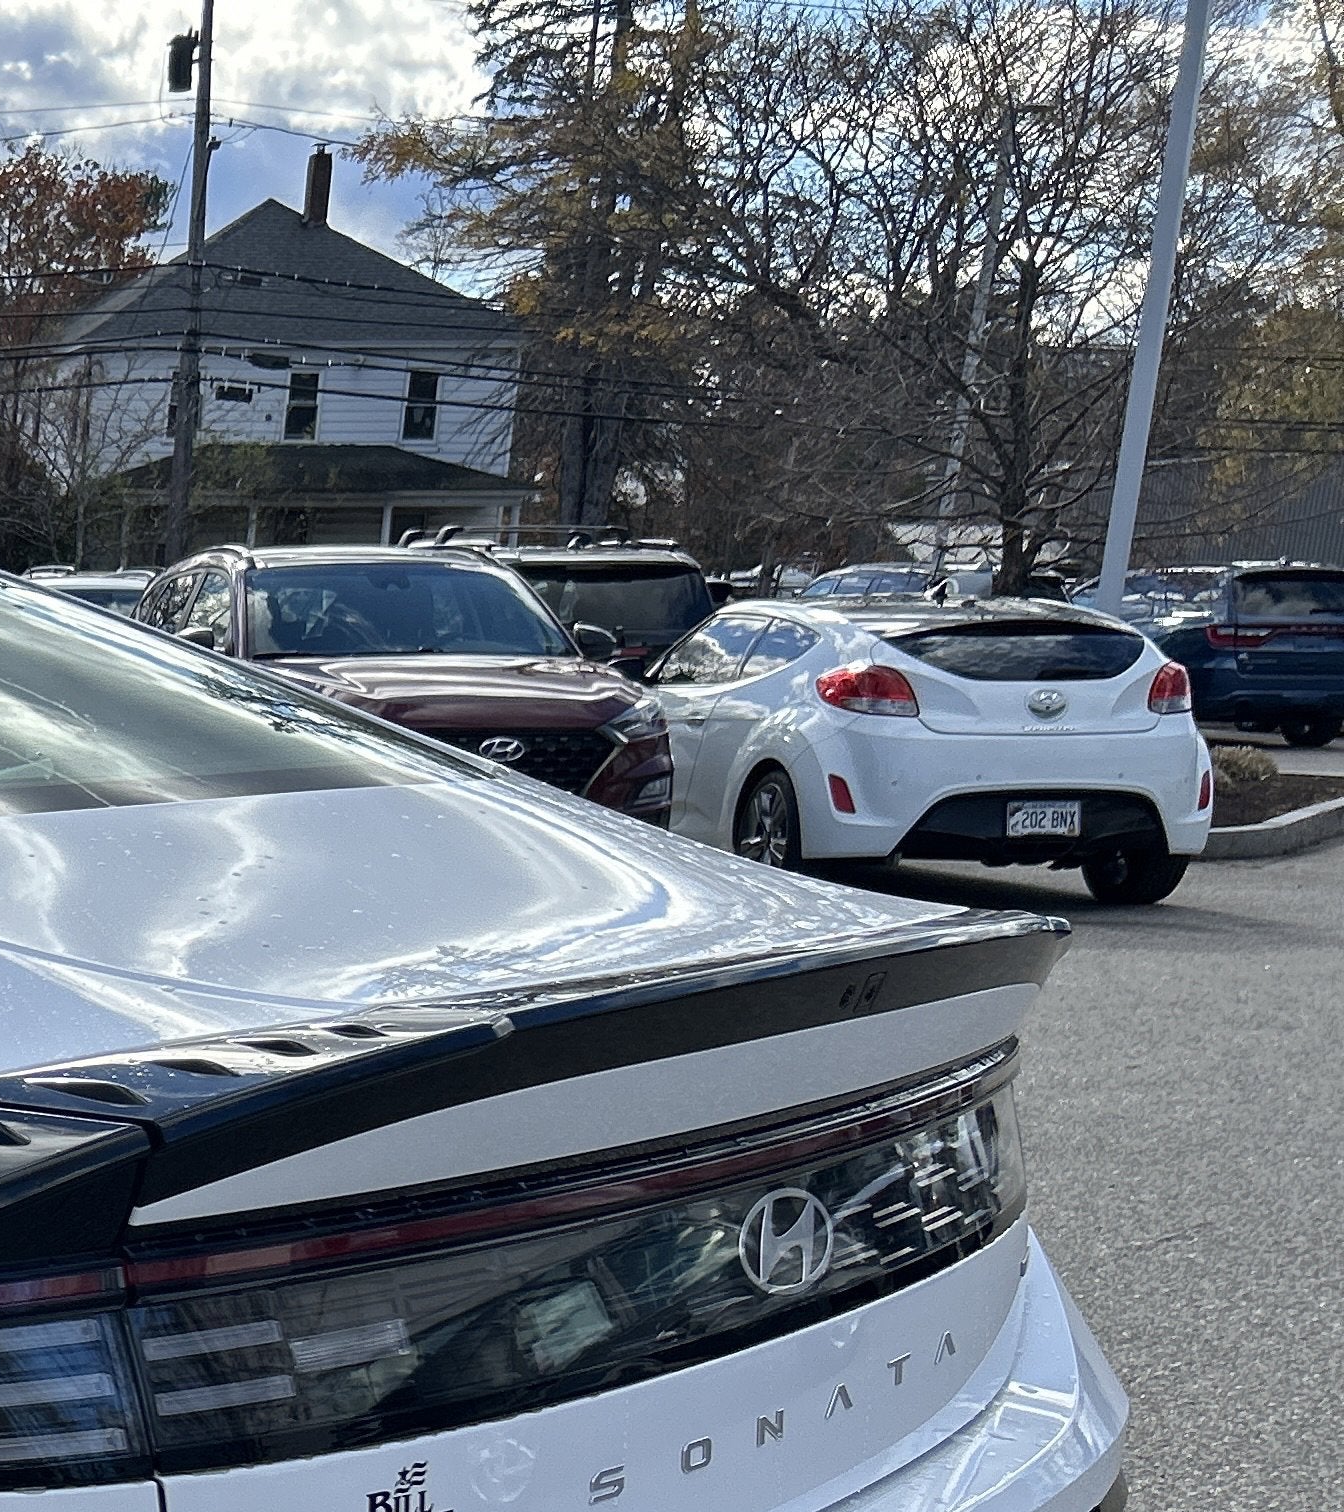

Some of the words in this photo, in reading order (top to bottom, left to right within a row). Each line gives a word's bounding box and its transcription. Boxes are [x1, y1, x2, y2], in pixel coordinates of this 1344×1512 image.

[1021, 810, 1047, 829] 202
[1051, 809, 1078, 829] BNX
[588, 1329, 957, 1506] SONATA
